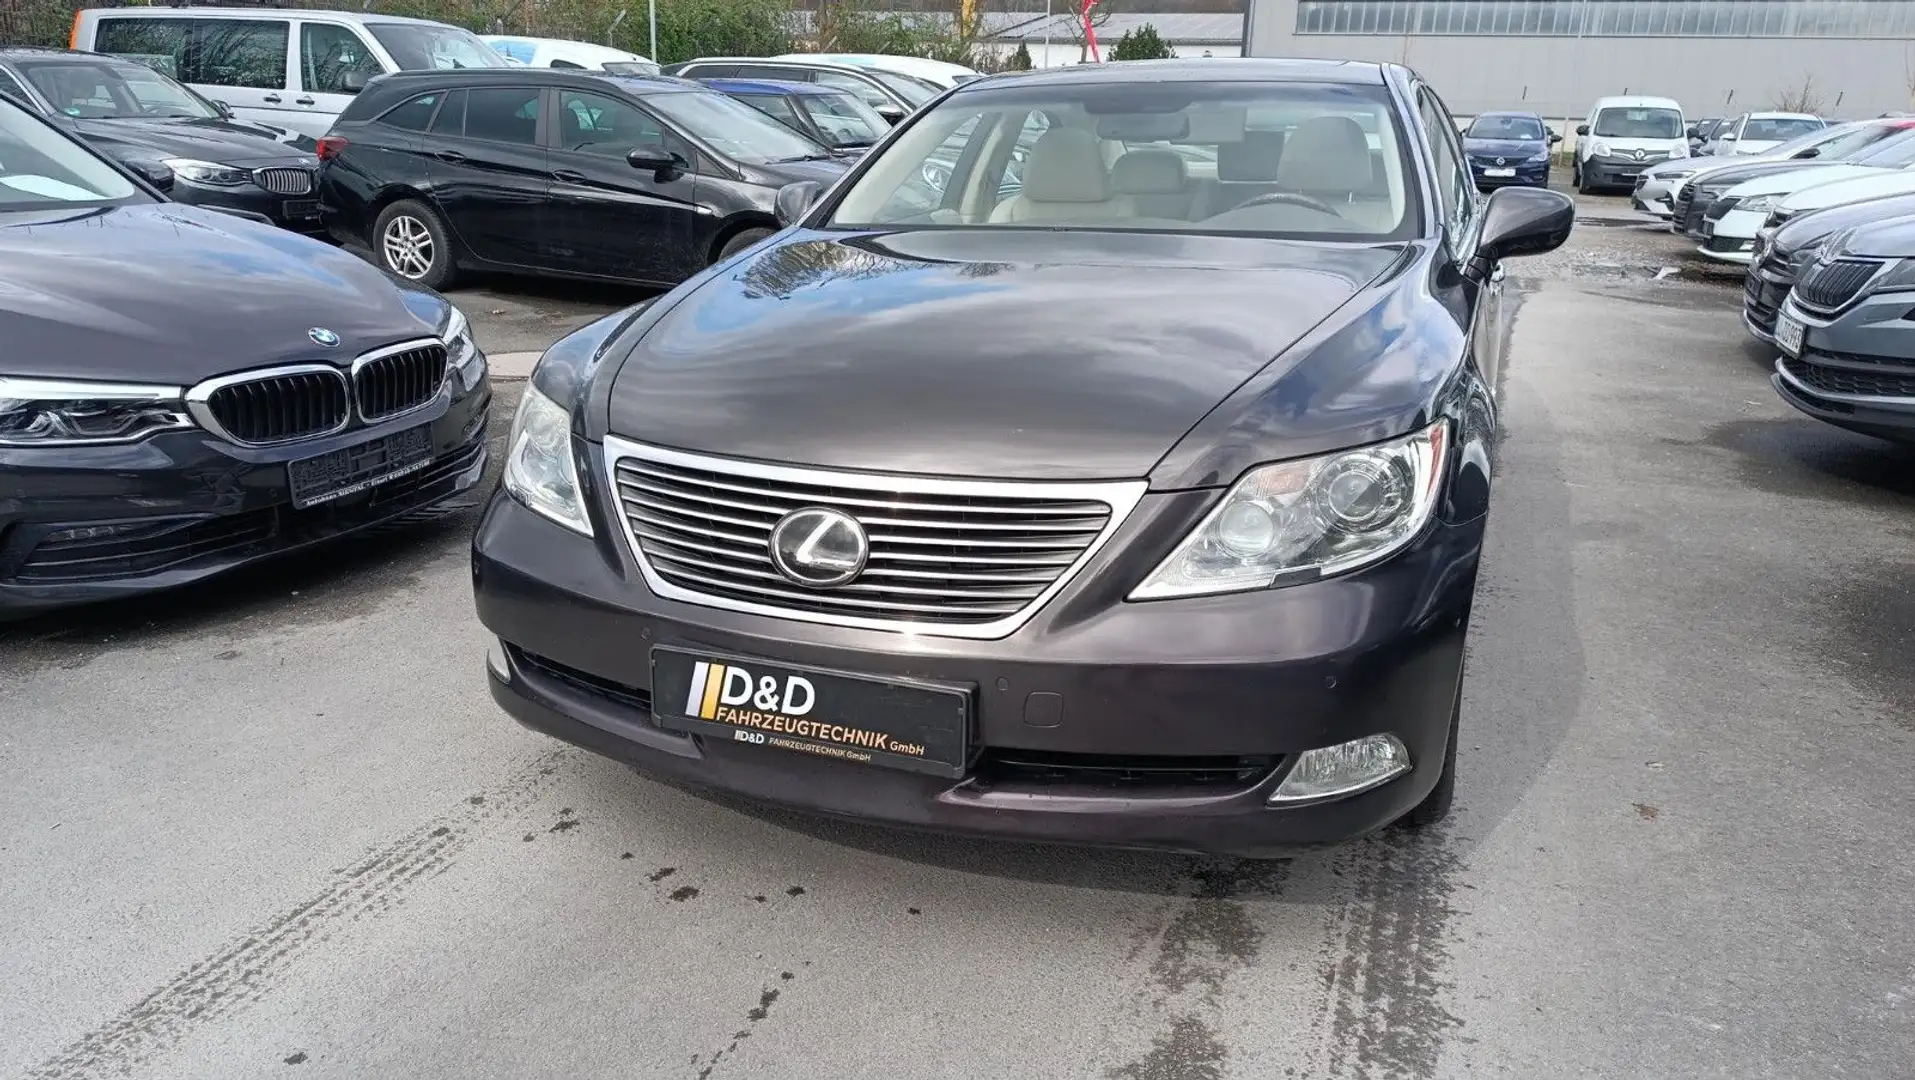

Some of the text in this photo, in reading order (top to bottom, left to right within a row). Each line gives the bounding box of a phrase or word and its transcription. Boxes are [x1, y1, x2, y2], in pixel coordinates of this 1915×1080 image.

[720, 665, 816, 716] D&D
[715, 706, 925, 756] FAHRZEUGTECHNIK GmbH
[740, 731, 871, 762] D&D FAHRZEUGTECHNIK GmbH
